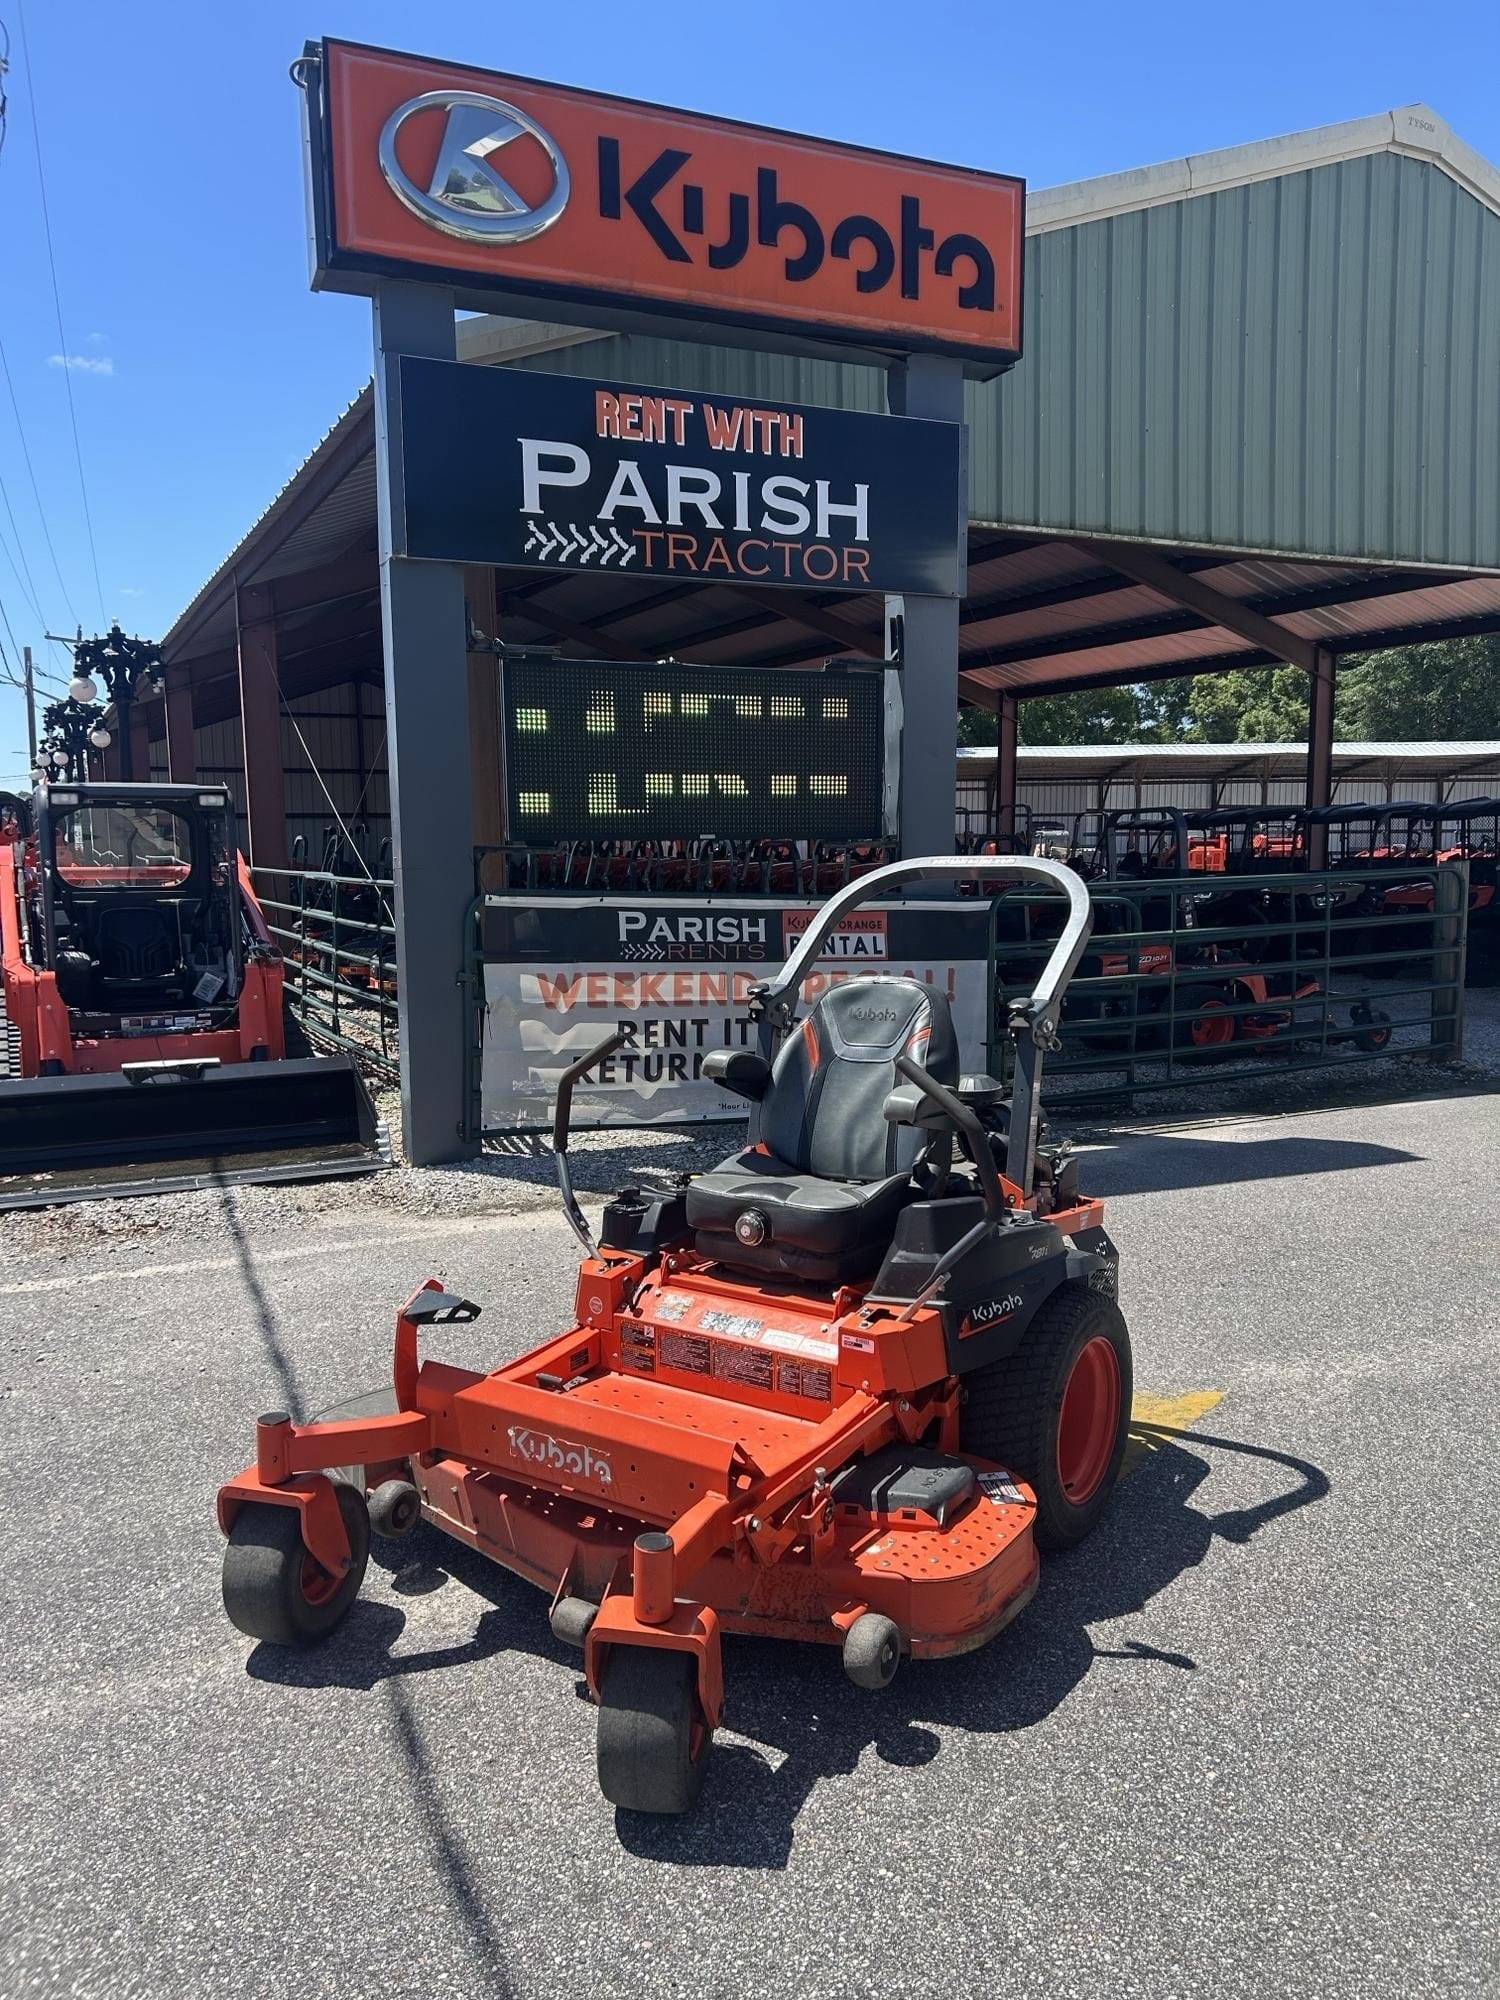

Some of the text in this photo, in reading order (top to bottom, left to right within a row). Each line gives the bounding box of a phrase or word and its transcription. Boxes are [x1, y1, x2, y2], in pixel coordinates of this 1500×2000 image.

[1408, 117, 1435, 132] TYSON
[598, 135, 996, 312] Kubota
[594, 390, 804, 459] RENT WITH
[516, 437, 870, 542] PARISH
[632, 529, 871, 583] TRACTOR
[617, 911, 767, 943] PARISH
[838, 920, 883, 929] ORANGE
[667, 943, 766, 960] RENTS
[536, 969, 759, 1010] WEEKEND
[848, 1007, 897, 1021] Kubota
[617, 1017, 752, 1049] RENT IT
[971, 1293, 1024, 1321] Kubota
[508, 1427, 612, 1484] Kubota
